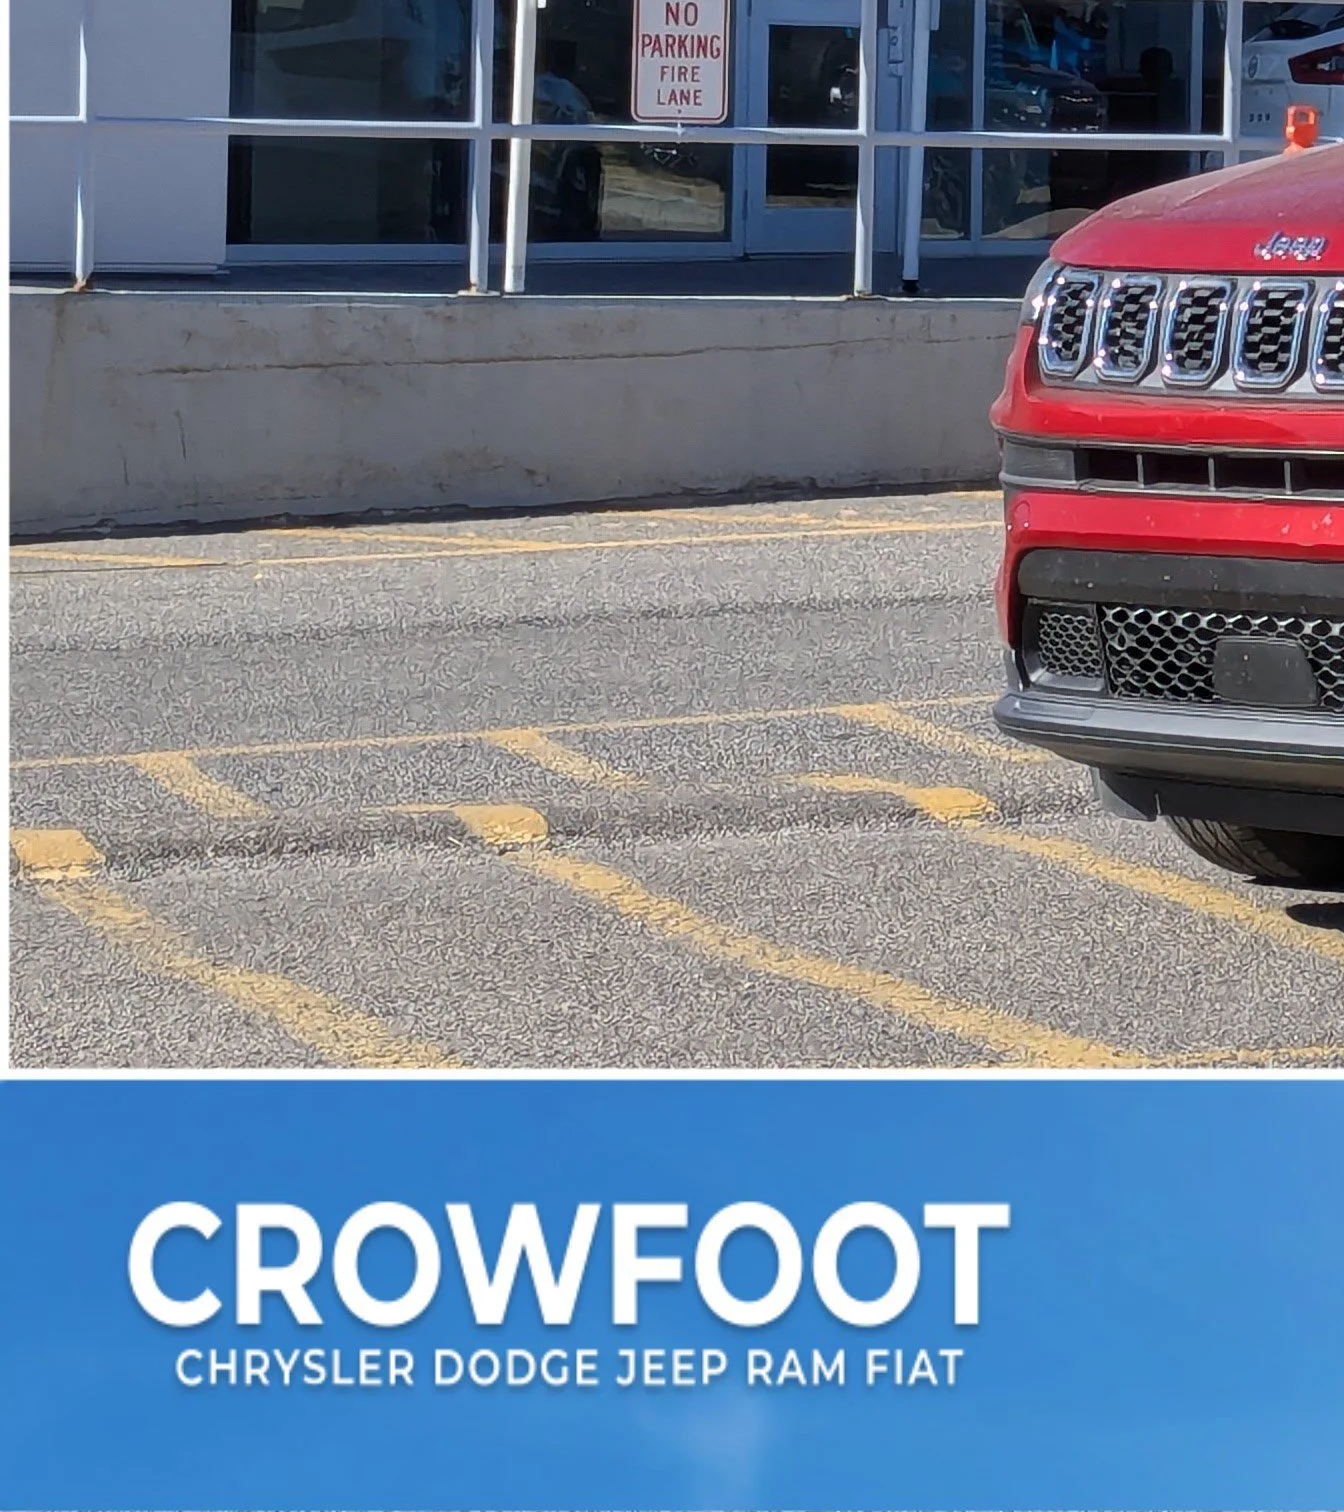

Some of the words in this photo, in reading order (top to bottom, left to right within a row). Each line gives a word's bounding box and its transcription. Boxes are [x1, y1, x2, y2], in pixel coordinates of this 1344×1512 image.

[665, 1, 699, 27] NO
[641, 33, 721, 59] PARKING
[660, 65, 701, 83] FIRE
[656, 88, 703, 107] LANE
[1253, 231, 1327, 261] Jeep
